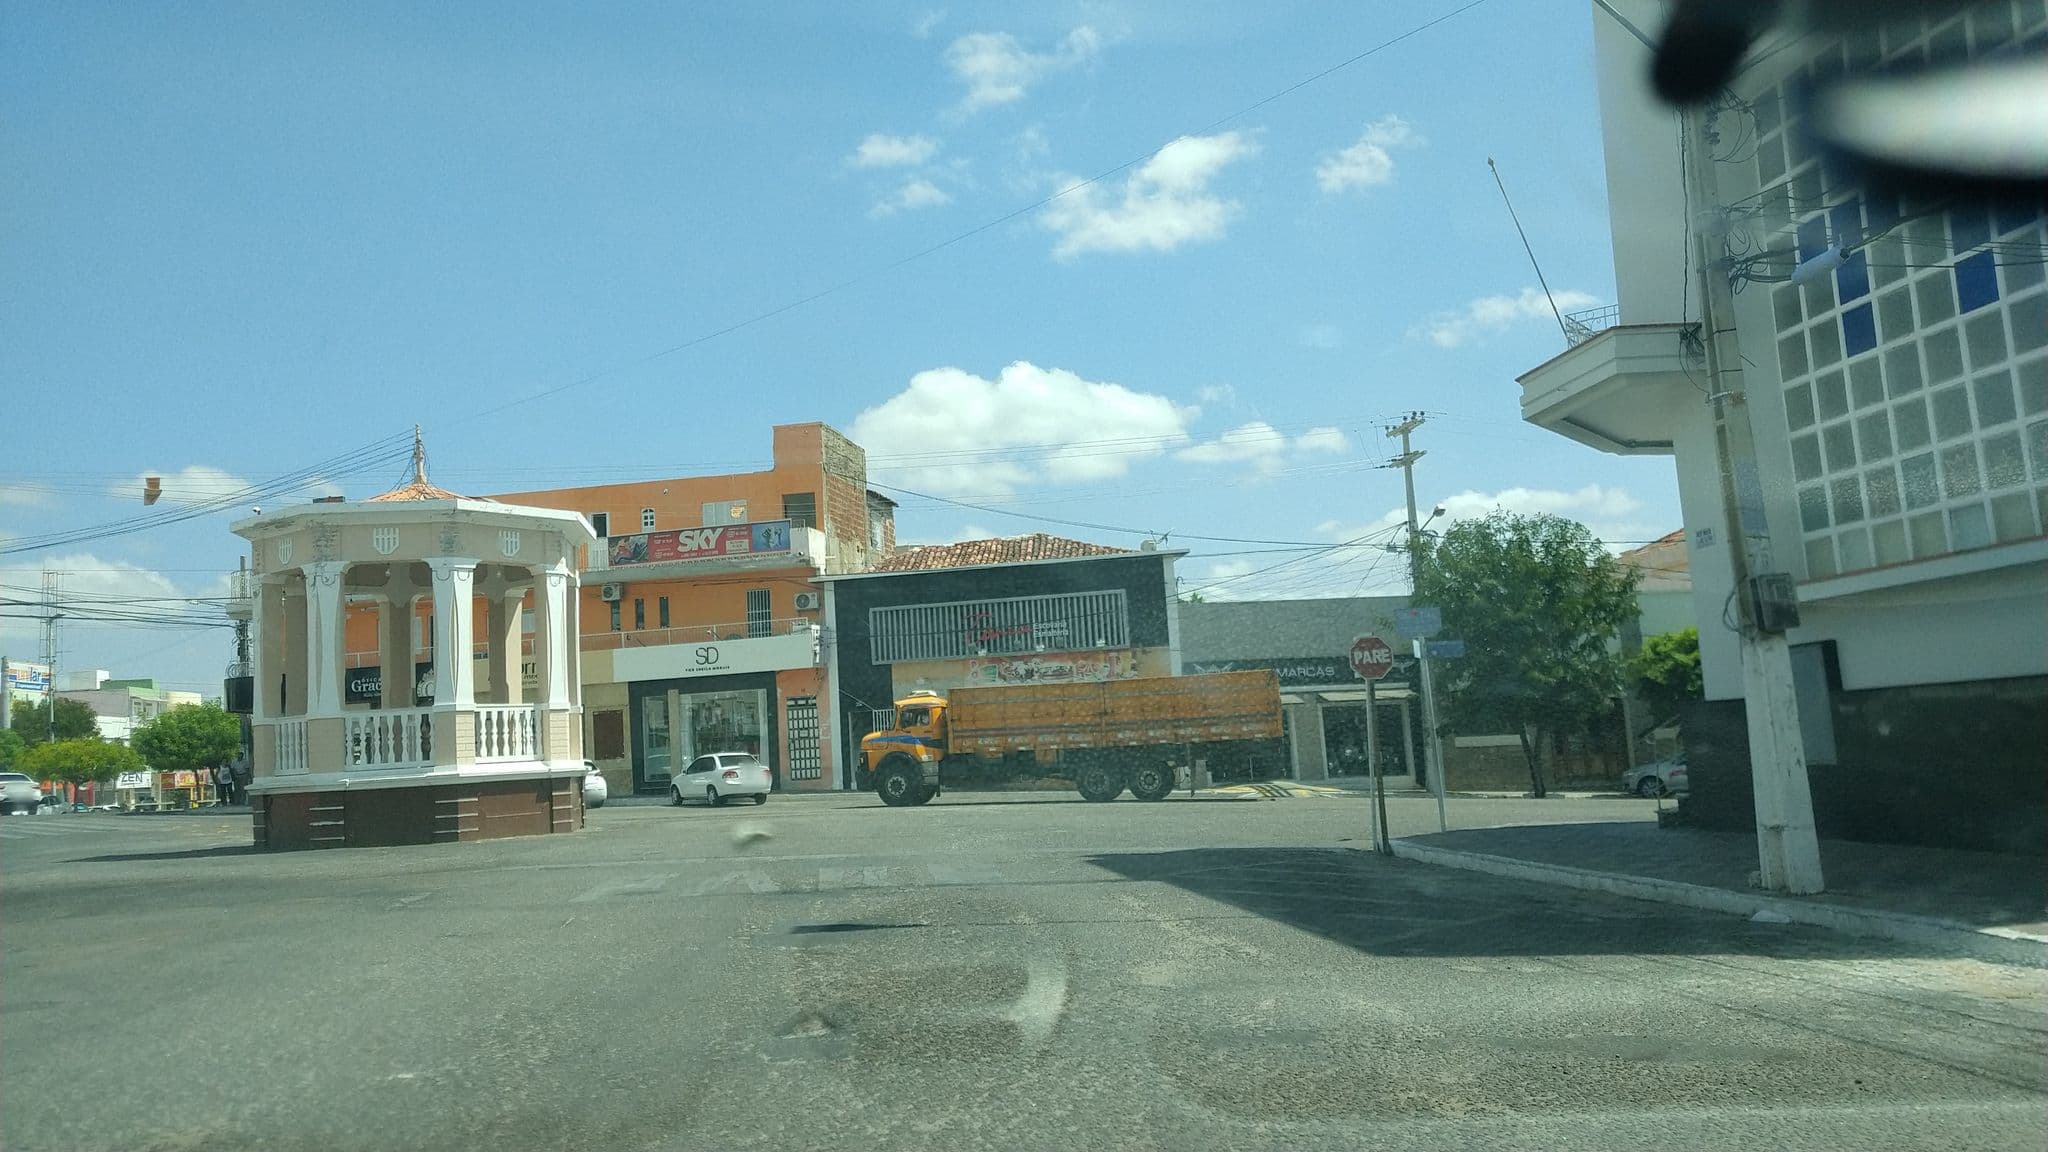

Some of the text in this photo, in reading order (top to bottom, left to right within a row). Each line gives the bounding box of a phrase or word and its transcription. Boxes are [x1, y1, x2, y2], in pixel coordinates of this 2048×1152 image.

[677, 527, 724, 553] SKY
[695, 646, 719, 665] SD
[1353, 648, 1391, 665] PARE
[1276, 666, 1335, 678] MARCAS
[121, 771, 143, 783] ZEN
